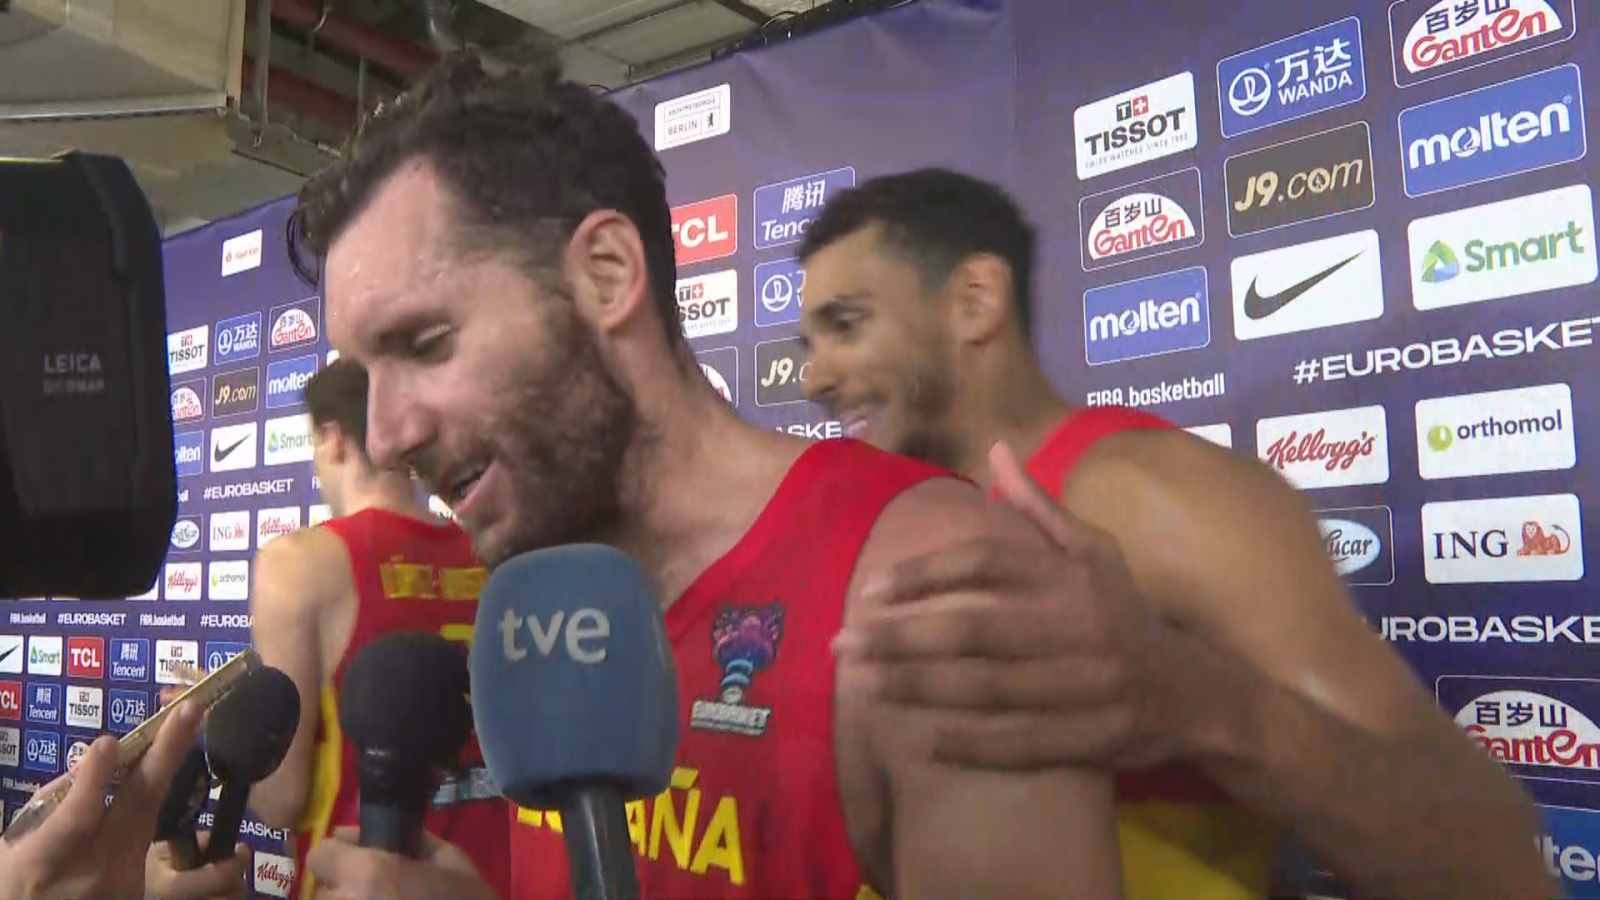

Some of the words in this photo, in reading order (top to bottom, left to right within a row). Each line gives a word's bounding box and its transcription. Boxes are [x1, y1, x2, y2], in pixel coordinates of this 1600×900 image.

[1425, 0, 1511, 34] 百岁山
[1275, 38, 1351, 88] 万达
[1278, 70, 1353, 105] WANDA
[667, 120, 698, 136] BERLIN
[1084, 106, 1186, 155] TISSOT
[1409, 102, 1571, 169] molten
[782, 179, 826, 214] 腾讯
[1233, 156, 1364, 212] J9.com
[1105, 198, 1163, 228] 百岁山
[761, 217, 814, 241] Tenc
[1464, 219, 1585, 272] Smart
[679, 297, 730, 323] SSOT
[1089, 296, 1200, 342] molten
[44, 354, 101, 373] LEICA
[169, 345, 205, 363] TISSOT
[761, 357, 812, 387] J9.c
[1457, 409, 1563, 441] orthomol
[175, 446, 201, 464] olten
[1266, 428, 1375, 471] Kellogg's
[203, 478, 294, 500] #EUROBASKET
[213, 527, 232, 541] ING
[1432, 529, 1509, 561] ING
[58, 613, 126, 625] #EUROBASKET
[498, 608, 610, 663] tve
[71, 648, 100, 667] TCL
[112, 662, 146, 677] Tencent
[0, 690, 18, 710] CL
[69, 703, 100, 716] TISSOT
[1475, 700, 1567, 728] 百岁山
